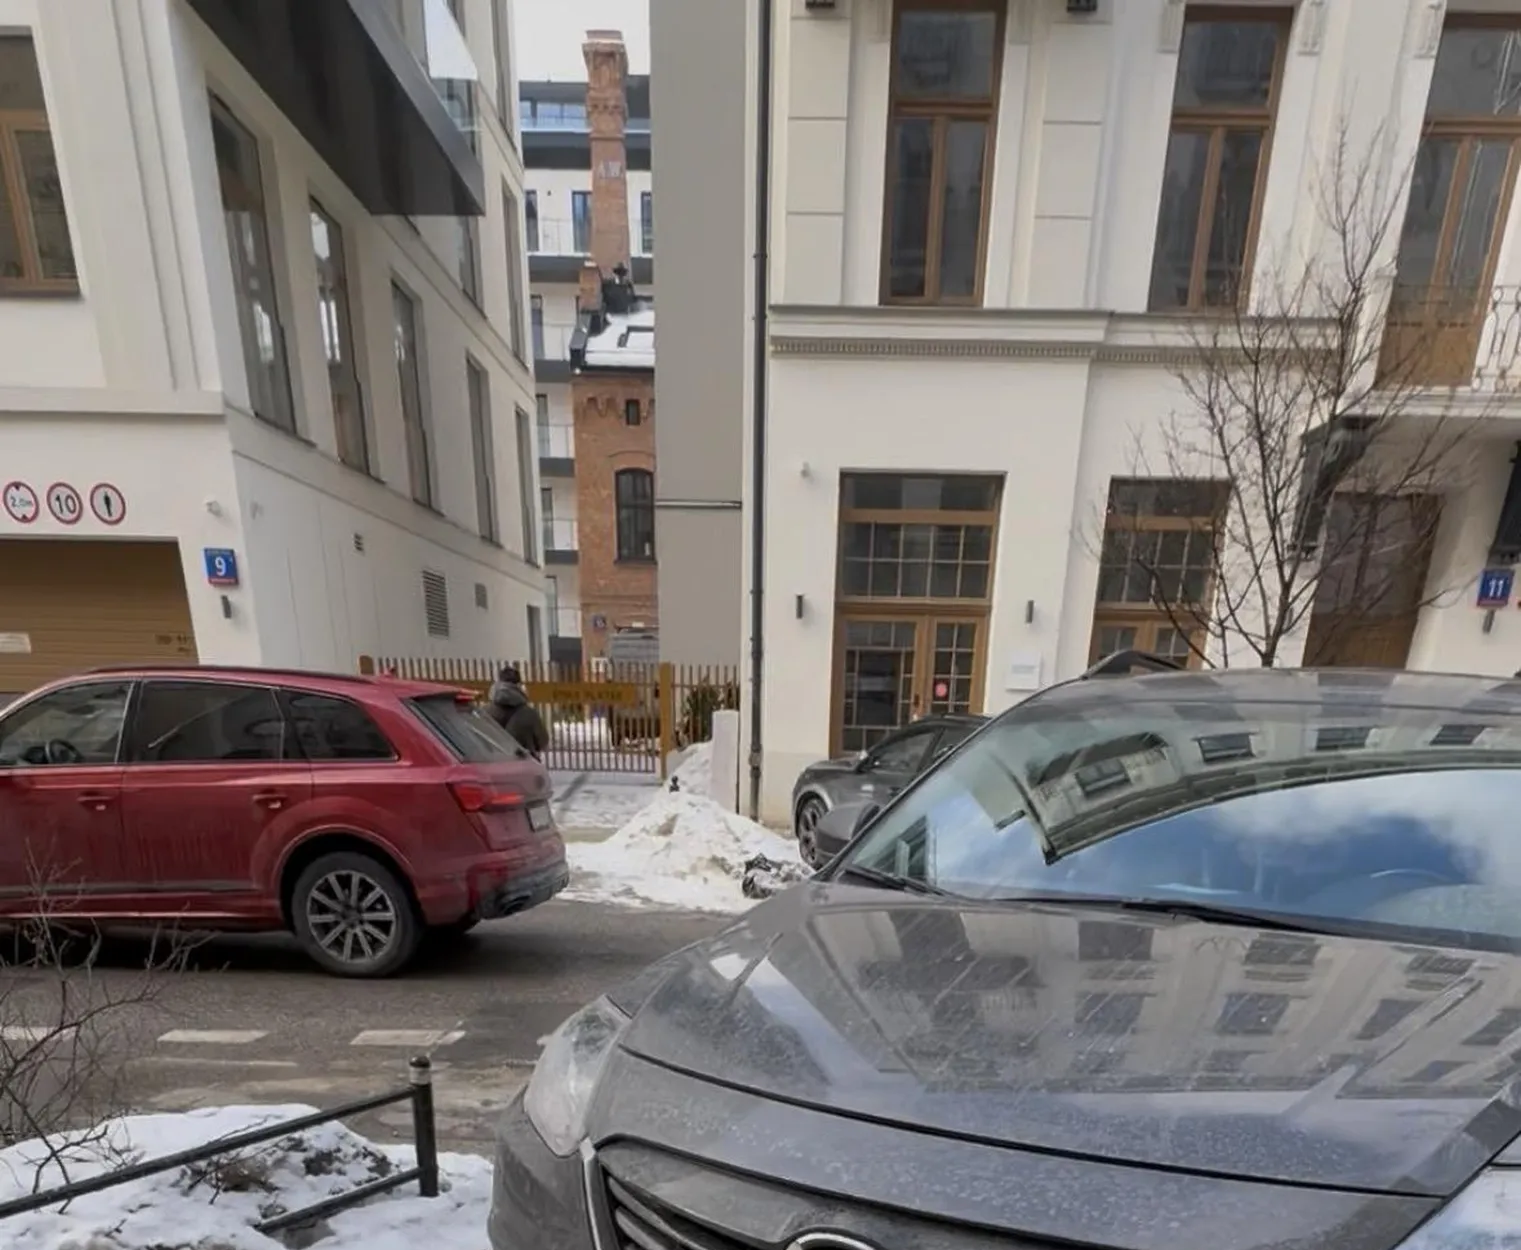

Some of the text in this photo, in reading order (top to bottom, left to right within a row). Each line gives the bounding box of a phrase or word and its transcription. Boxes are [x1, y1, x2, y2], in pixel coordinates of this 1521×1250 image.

[55, 494, 76, 514] 10
[215, 556, 227, 577] 9
[1489, 578, 1505, 598] 11
